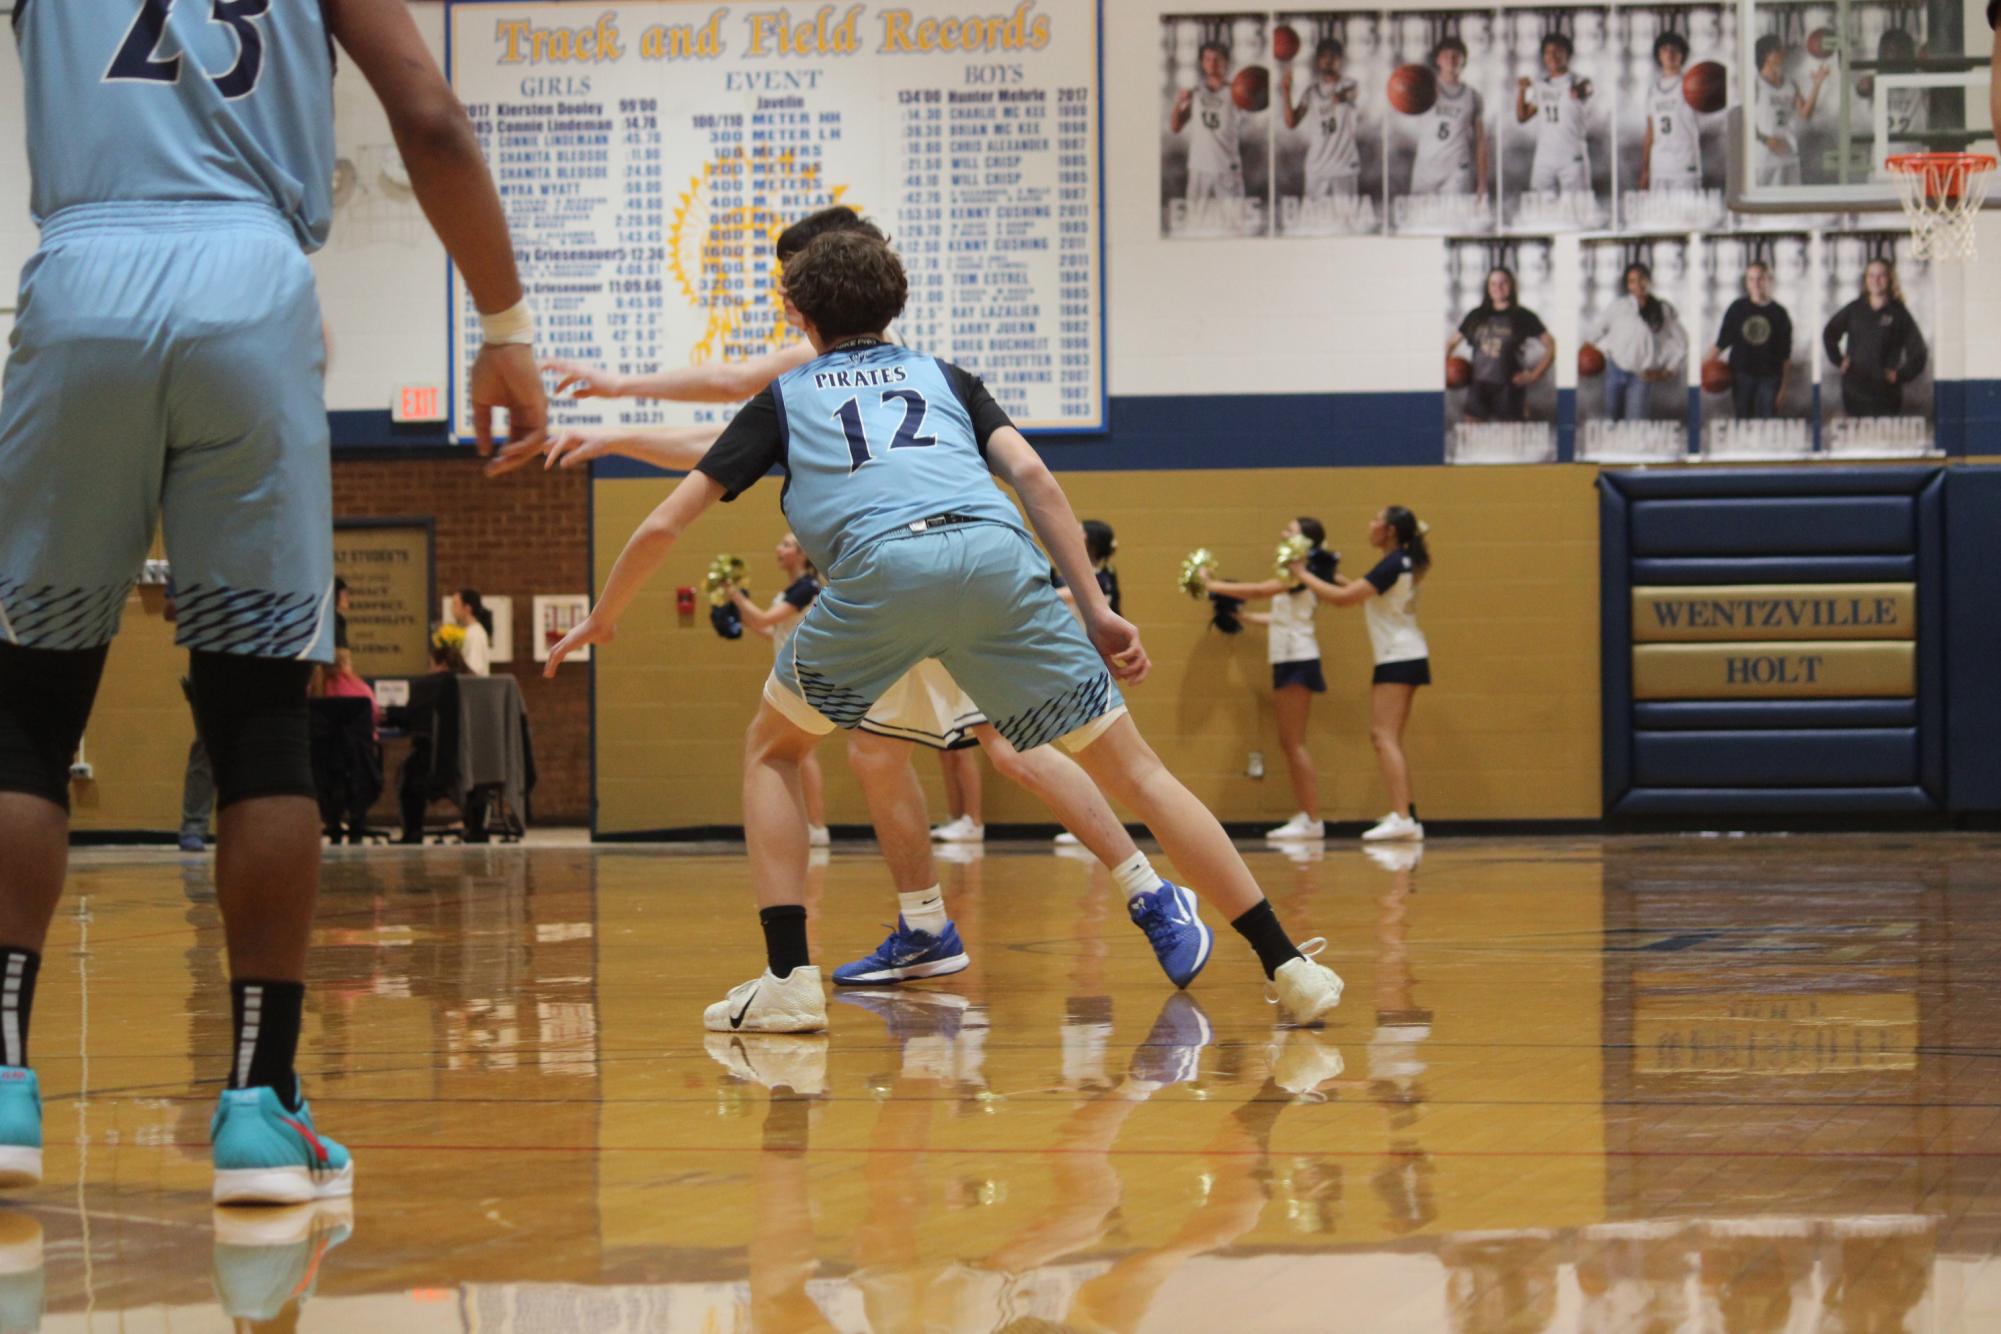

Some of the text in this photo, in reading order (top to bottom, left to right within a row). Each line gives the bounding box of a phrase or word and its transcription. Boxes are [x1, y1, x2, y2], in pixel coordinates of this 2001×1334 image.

[495, 1, 1052, 65] Track and Field Records
[725, 69, 824, 92] EVENT
[964, 63, 1024, 84] BOYS
[520, 77, 592, 97] GIRLS
[948, 90, 994, 103] Hunter
[1057, 88, 1088, 102] 2017
[467, 103, 490, 118] 017
[497, 102, 553, 116] Kiersten
[558, 102, 603, 116] Dooley
[757, 96, 804, 110] Javelin
[950, 107, 996, 120] CHARLIE
[1003, 106, 1019, 119] MC
[1025, 105, 1046, 118] KEE
[497, 119, 543, 132] Connie
[548, 117, 613, 131] Lindeman
[692, 113, 743, 130] 100/110
[752, 112, 810, 125] METER
[1660, 116, 1672, 134] 3
[950, 123, 988, 136] BRIAN
[994, 123, 1012, 135] MC
[1018, 122, 1040, 135] KEE
[499, 134, 539, 147] CONNIE
[710, 130, 743, 144] 300
[752, 129, 810, 142] METER
[752, 145, 823, 158] METERS
[950, 140, 981, 153] CHRIS
[987, 138, 1049, 151] ALEXANDER
[500, 149, 609, 164] SHANITA BLEDSOE
[952, 156, 979, 170] WILL
[985, 155, 1022, 169] CRISP
[500, 167, 550, 180] SHANITA
[557, 166, 609, 179] BLEDSOE
[752, 161, 822, 175] METERS
[710, 178, 823, 192] 400 METERS
[952, 173, 979, 186] WILL
[985, 172, 1022, 185] CRISP
[500, 183, 580, 197] MYRA WYATT
[711, 196, 743, 208] 400
[782, 194, 834, 206] RELAY
[951, 206, 990, 219] KENNY
[997, 205, 1051, 218] CUSHING
[1059, 204, 1089, 217] 2011
[948, 239, 989, 252] KENNY
[995, 238, 1049, 251] CUSHING
[1060, 238, 1087, 251] 2011
[1060, 254, 1089, 267] 2011
[953, 273, 978, 285] TOM
[984, 272, 1028, 285] ESTREL
[534, 281, 603, 295] Griesenauer
[952, 306, 975, 318] RAY
[550, 313, 593, 326] KUSIAK
[550, 329, 593, 342] KUSIAK
[731, 327, 774, 340] SHOT
[951, 323, 990, 335] LARRY
[996, 322, 1037, 334] JUERN
[724, 343, 767, 355] HIGH
[953, 340, 984, 351] GREG
[555, 347, 602, 359] ROLAND
[814, 366, 907, 389] PIRATES
[1003, 371, 1052, 384] HAWKINS
[997, 387, 1026, 400] TOTH
[402, 387, 439, 418] EXIT
[832, 388, 937, 477] 12
[1653, 598, 1897, 628] WENTZVILLE
[1726, 656, 1823, 685] HOLT
